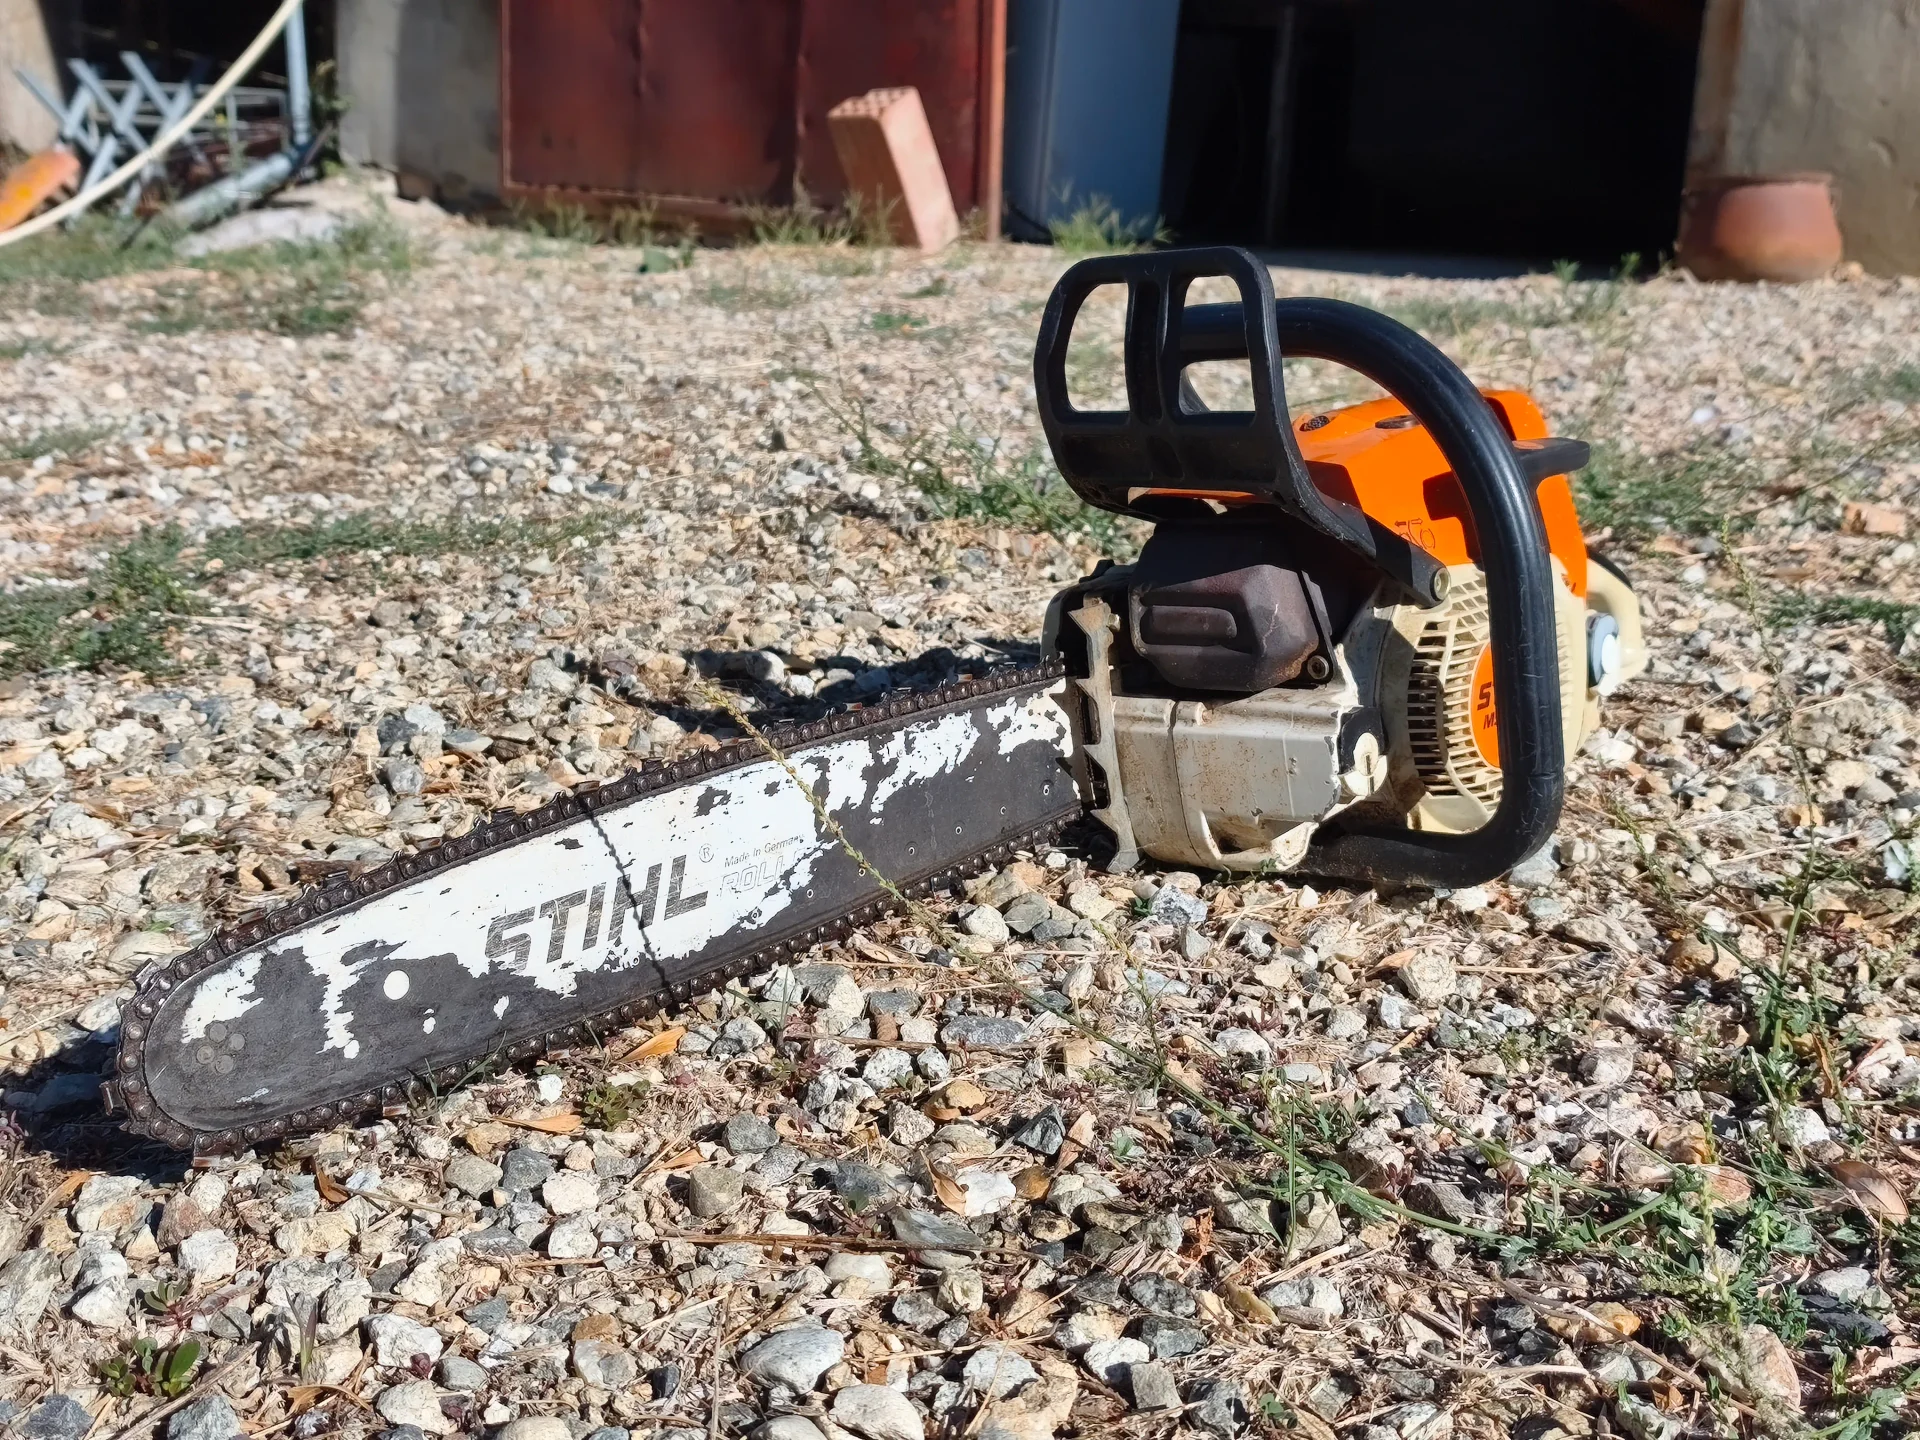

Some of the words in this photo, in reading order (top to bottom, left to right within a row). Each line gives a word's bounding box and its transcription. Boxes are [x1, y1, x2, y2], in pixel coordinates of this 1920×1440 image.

[1477, 682, 1494, 710] S
[724, 852, 750, 868] Made
[485, 854, 709, 970] STIHL
